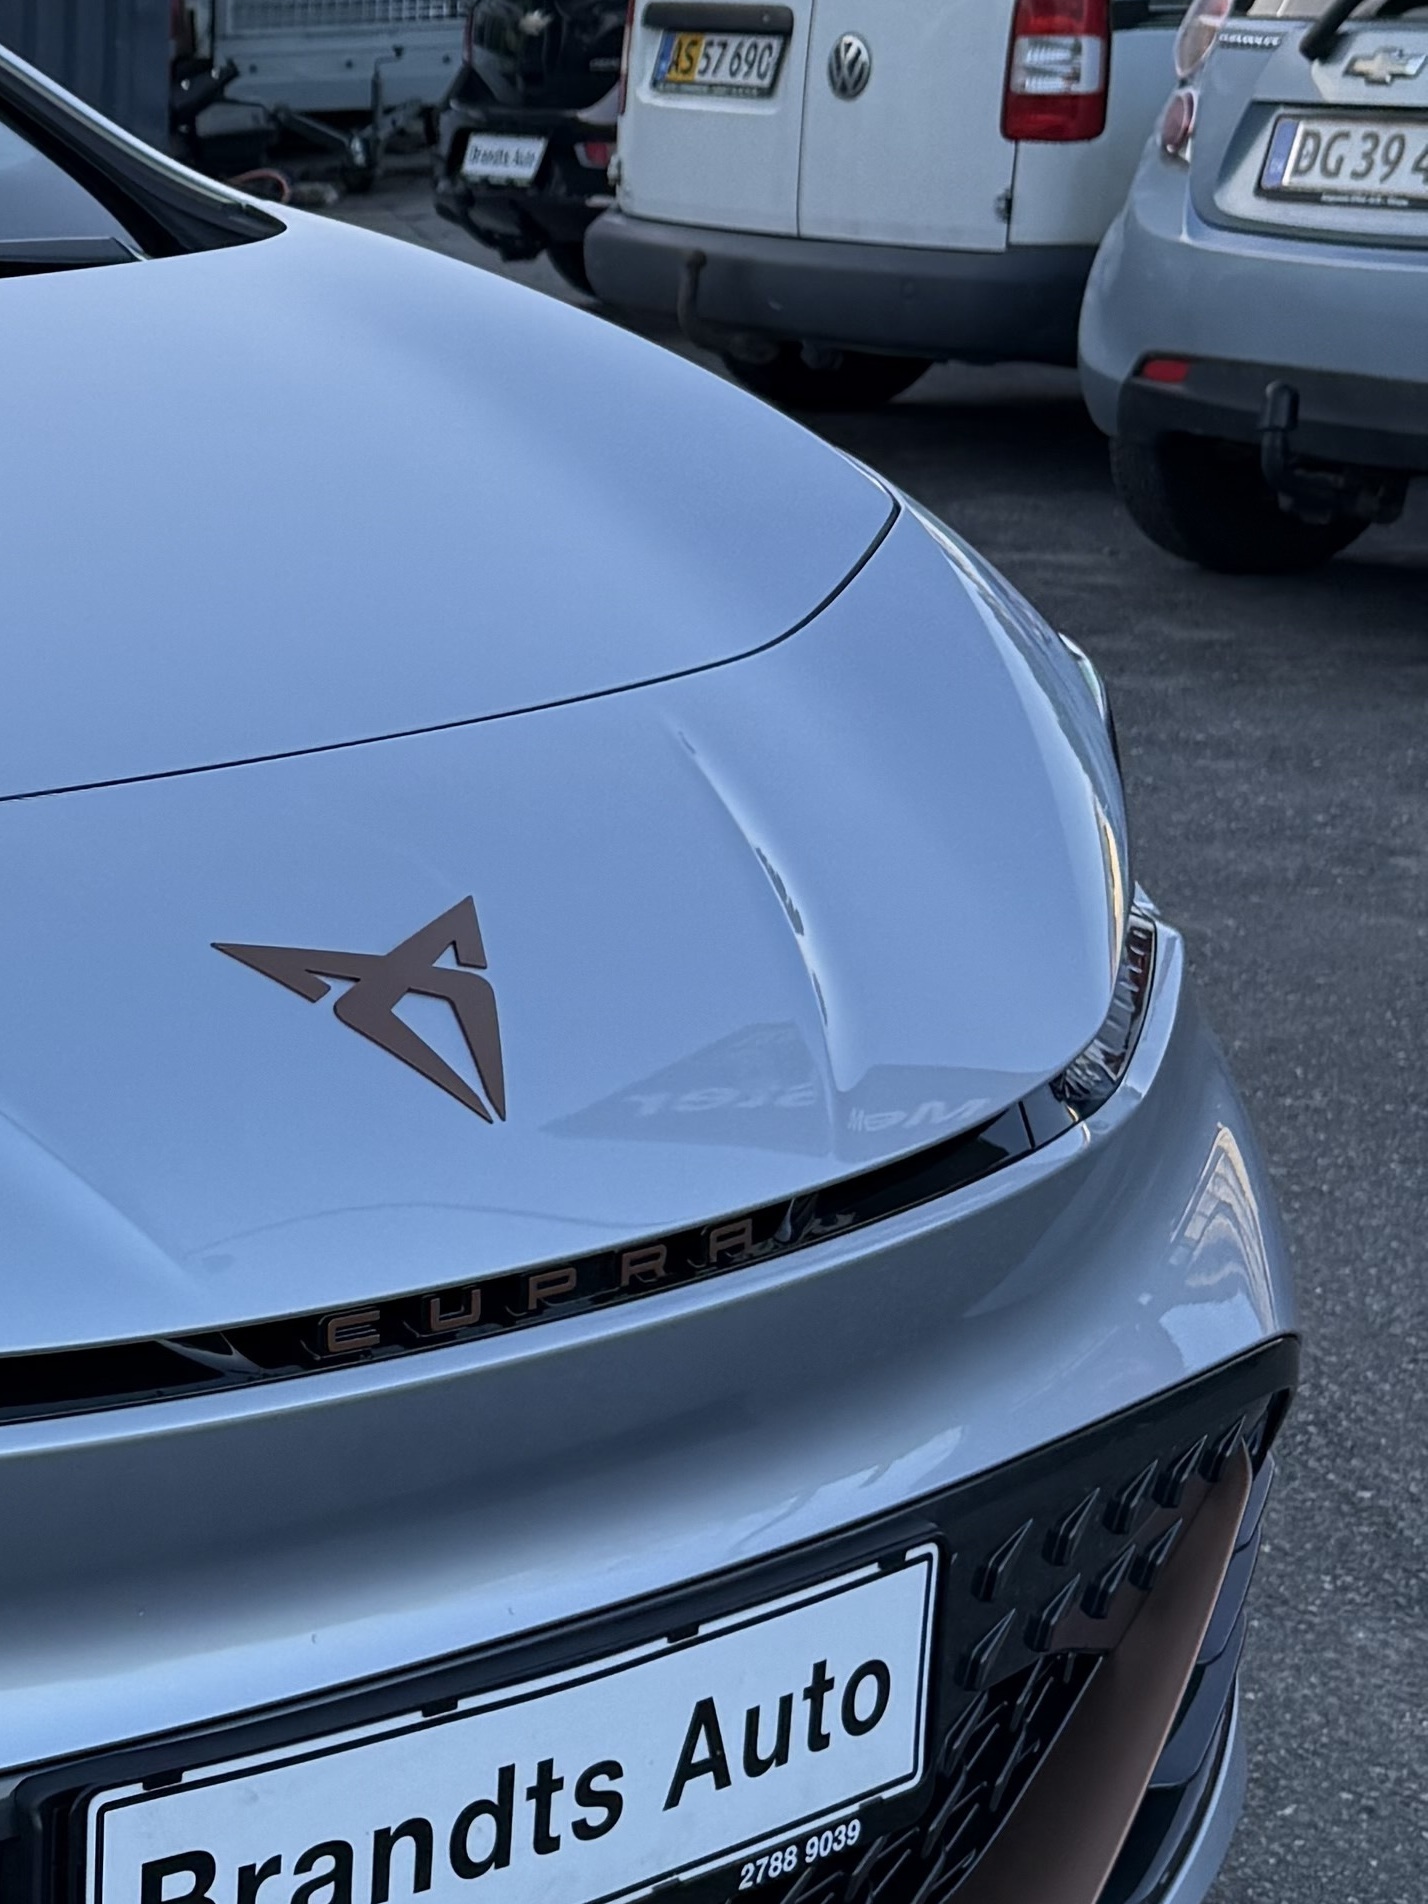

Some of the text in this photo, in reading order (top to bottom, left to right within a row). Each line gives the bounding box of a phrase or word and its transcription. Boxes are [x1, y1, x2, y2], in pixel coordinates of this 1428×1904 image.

[668, 38, 698, 75] AS
[697, 40, 728, 78] 57
[1295, 130, 1350, 179] DG
[1350, 131, 1406, 184] 39
[327, 1218, 752, 1353] CUPRA
[662, 1657, 891, 1812] Auto
[738, 1818, 861, 1891] 2788 9039
